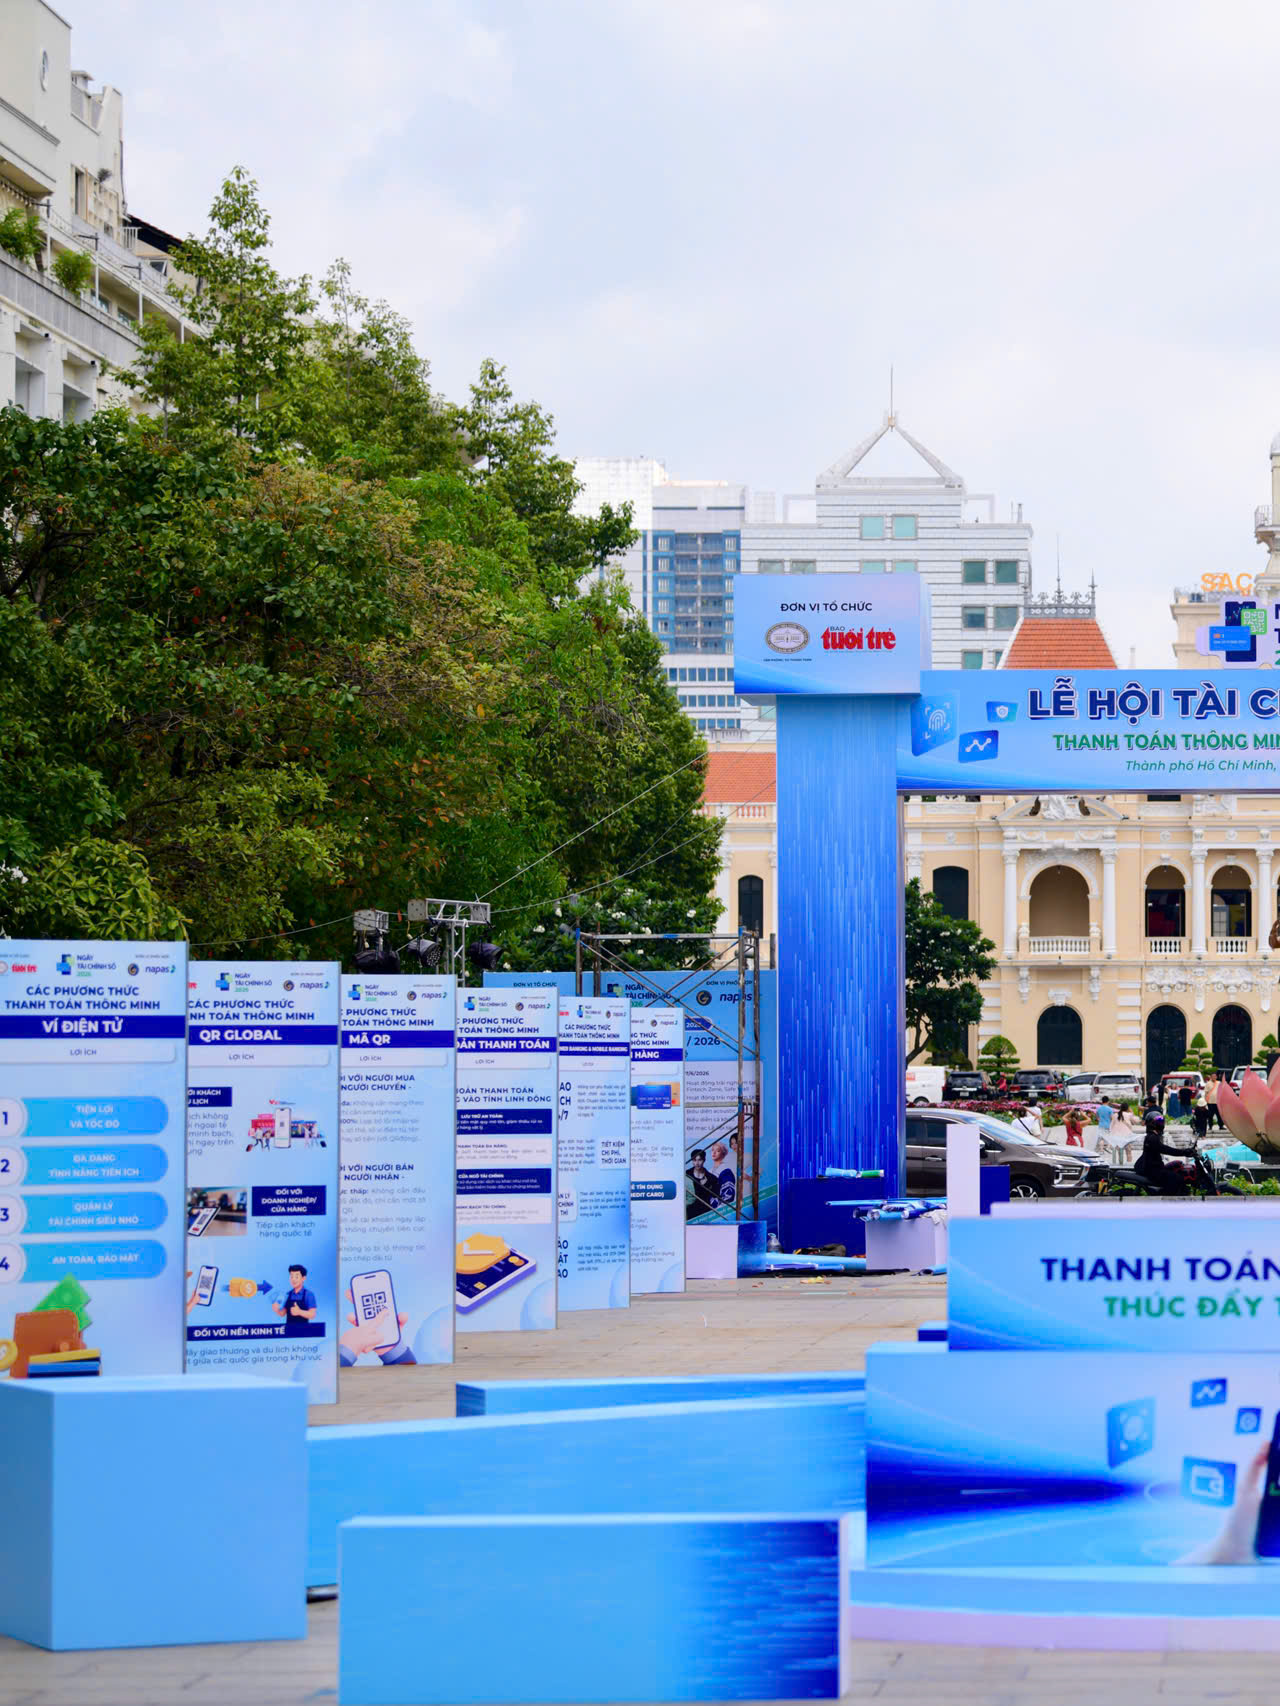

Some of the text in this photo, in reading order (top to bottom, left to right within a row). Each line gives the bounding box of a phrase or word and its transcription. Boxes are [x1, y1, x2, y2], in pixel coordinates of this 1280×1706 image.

[780, 600, 873, 613] ĐƠN VỊ TỔ CHỨC
[821, 626, 897, 650] tuổi trẻ
[1028, 676, 1077, 720] LỄ
[1088, 680, 1162, 726] HỘI
[1171, 680, 1238, 720] TÀI
[1053, 734, 1119, 750] THANH
[1124, 730, 1177, 750] TOÁN
[1181, 730, 1248, 750] THÔNG
[1126, 760, 1166, 771] Thành
[1169, 759, 1195, 773] phố
[1197, 760, 1215, 771] Hồ
[1218, 760, 1239, 771] Chí
[1242, 760, 1277, 772] Minh,
[145, 966, 169, 974] napas
[26, 984, 139, 996] CÁC PHƯƠNG THỨC
[5, 998, 160, 1009] THANH TOÁN THÔNG MINH
[188, 998, 295, 1009] CÁC PHƯƠNG THỨC
[208, 1011, 315, 1020] TOÁN THÔNG MINH
[346, 1007, 416, 1016] PHƯƠNG THỨC
[42, 1016, 124, 1036] VÍ ĐIỆN TỬ
[342, 1018, 369, 1026] TOÁN
[372, 1018, 406, 1026] THÔNG
[200, 1029, 282, 1042] QR GLOBAL
[349, 1032, 391, 1045] MÃ QR
[694, 1037, 721, 1045] 2026
[479, 1040, 517, 1049] THANH
[519, 1039, 550, 1049] TOÁN
[84, 1048, 97, 1056] ÍCH
[635, 1050, 659, 1059] HÀNG
[196, 1088, 221, 1096] KHÁCH
[2, 1111, 9, 1125] 1
[0, 1159, 10, 1173] 2
[0, 1208, 9, 1221] 3
[0, 1257, 10, 1270] 4
[1041, 1257, 1170, 1282] THANH
[1105, 1289, 1185, 1318] THÚC
[194, 1325, 286, 1337] ĐỐI VỚI NỀN KINH TẾ
